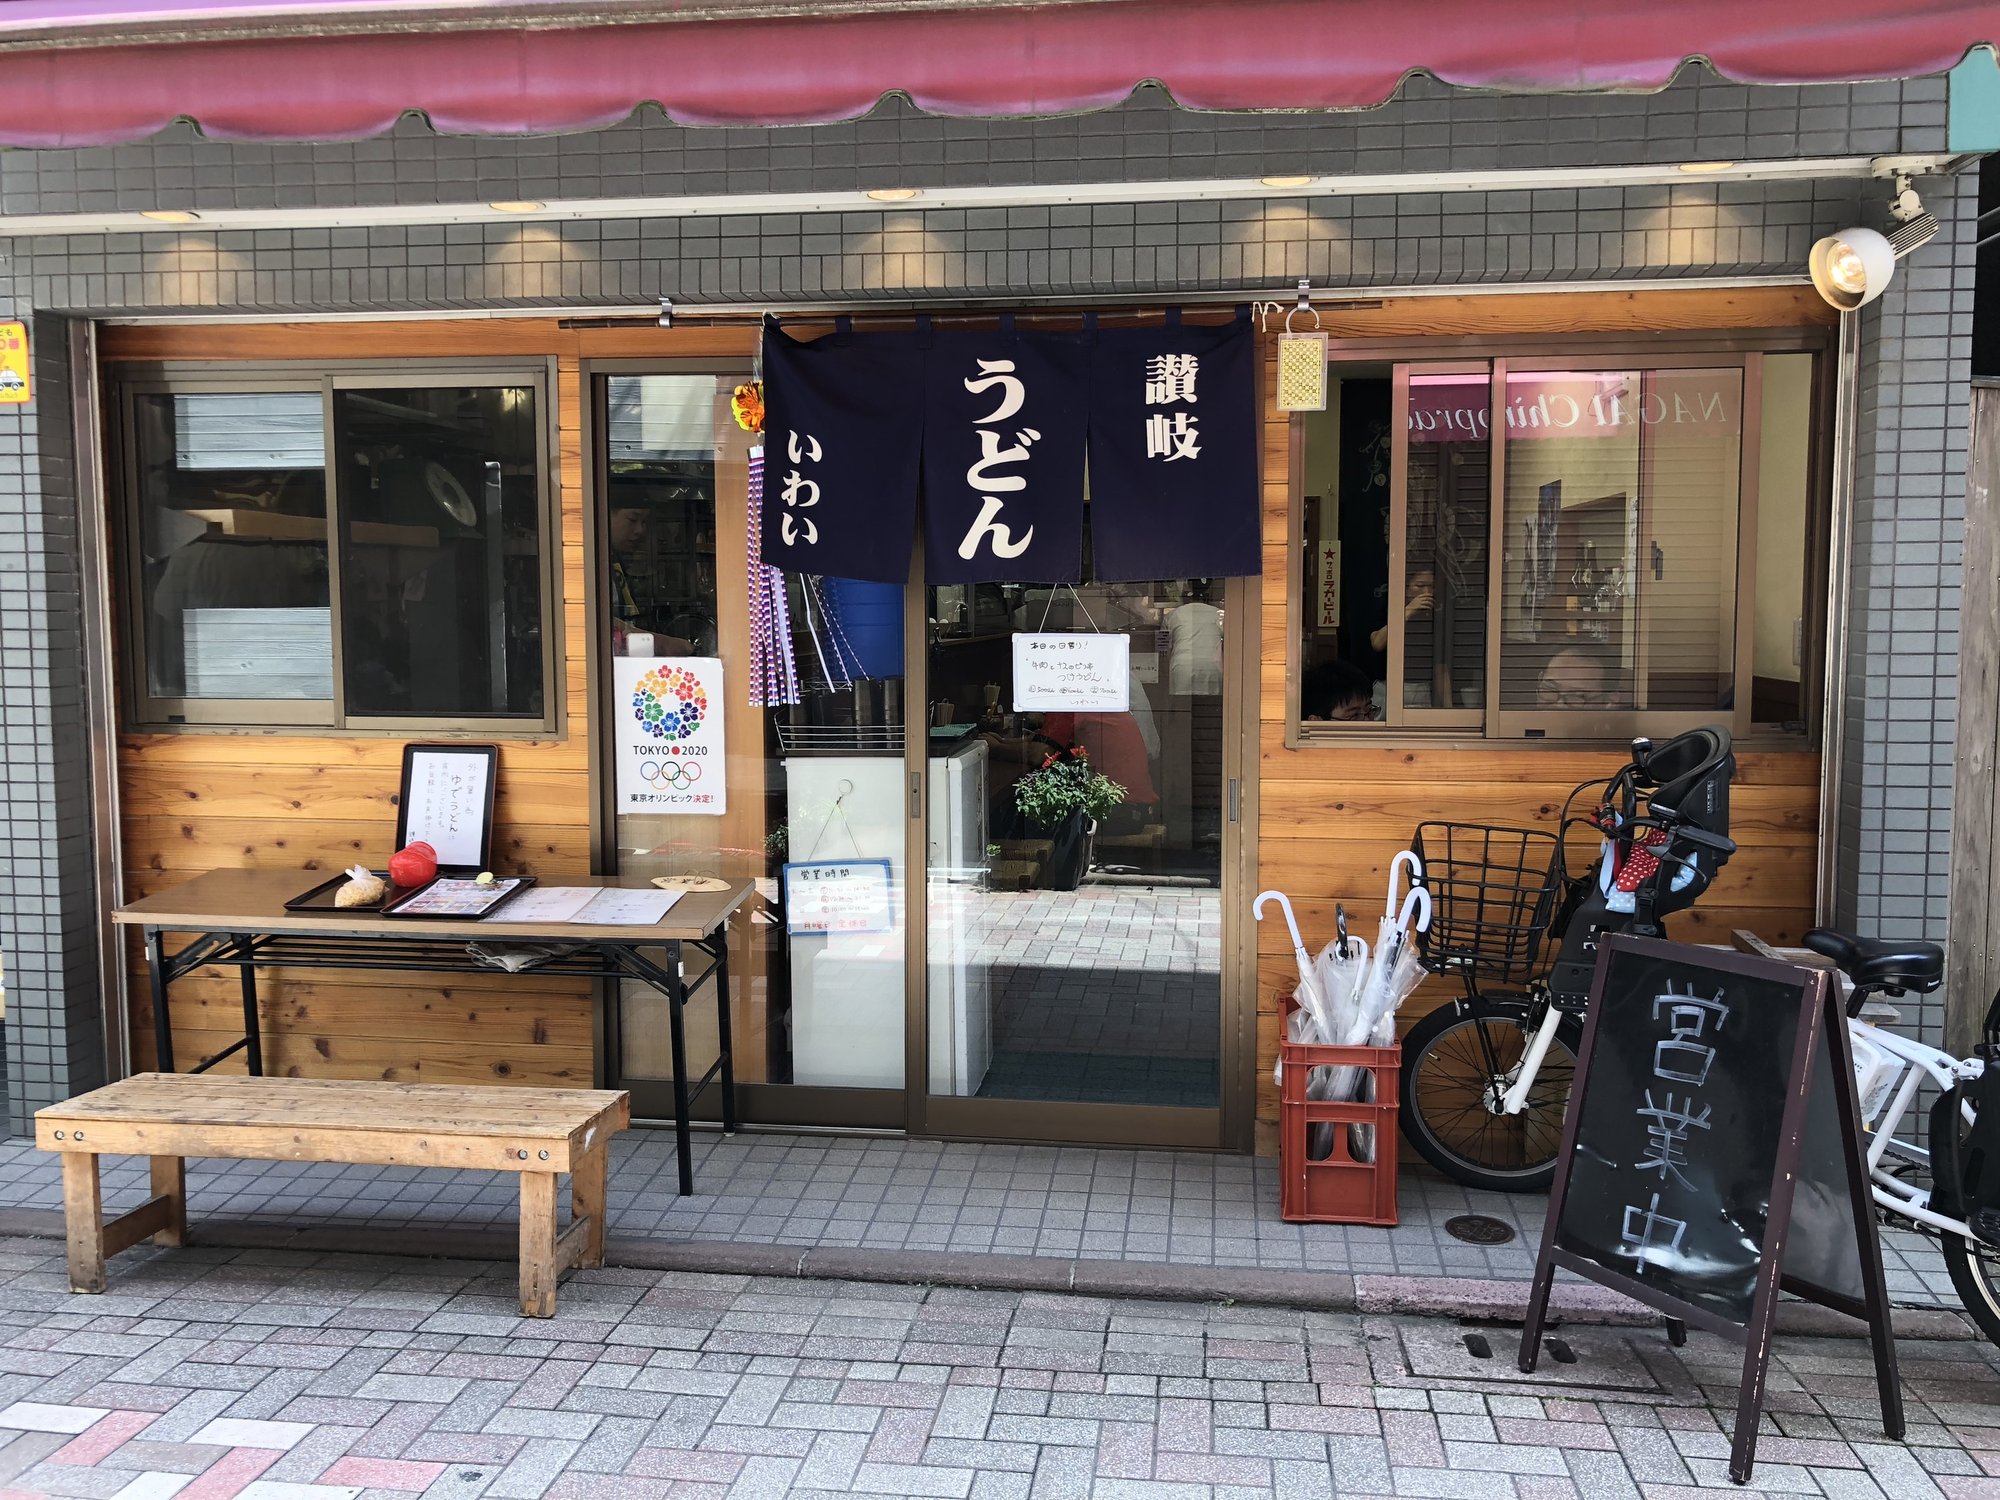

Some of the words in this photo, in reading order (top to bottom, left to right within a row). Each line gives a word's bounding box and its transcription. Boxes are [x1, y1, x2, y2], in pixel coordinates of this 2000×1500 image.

[780, 429, 823, 546] いわい
[956, 357, 1042, 560] うどん
[633, 745, 670, 756] TOKYO
[682, 745, 708, 756] 2020
[1621, 977, 1730, 1276] 営業中
